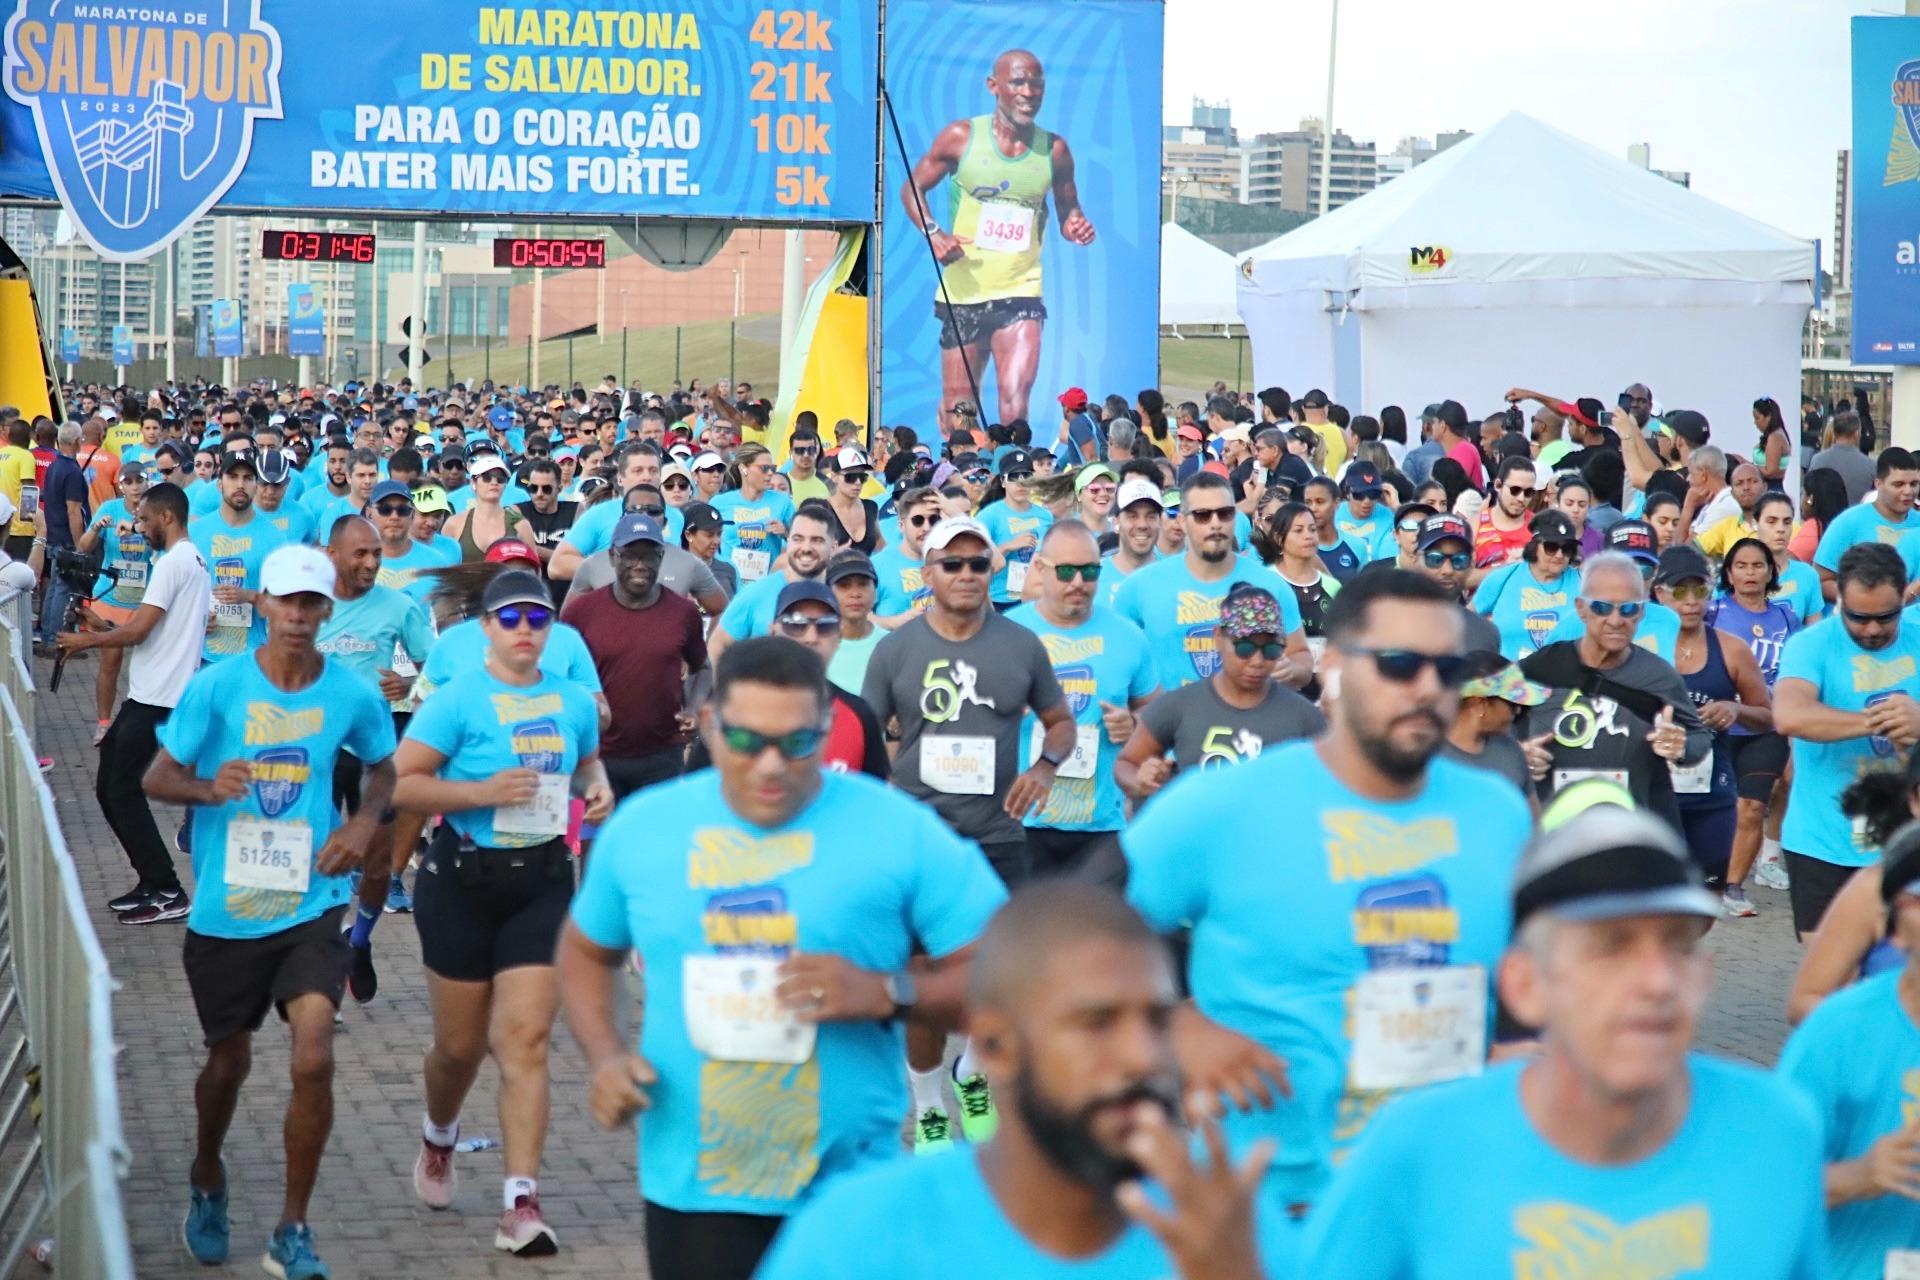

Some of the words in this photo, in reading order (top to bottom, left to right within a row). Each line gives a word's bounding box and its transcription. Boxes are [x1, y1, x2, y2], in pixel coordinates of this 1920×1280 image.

[74, 5, 178, 24] MARATONA
[184, 12, 208, 25] DE
[479, 8, 701, 50] MARATONA
[750, 10, 833, 51] 42k
[16, 20, 269, 105] SALVADOR
[420, 53, 472, 91] DE
[484, 54, 701, 97] SALVADOR.
[750, 61, 832, 103] 21k
[80, 101, 136, 114] 2023
[354, 104, 461, 144] PARA
[474, 107, 500, 145] O
[512, 103, 701, 159] CORAÇÃO
[750, 113, 832, 155] 10k
[311, 151, 437, 190] BATER
[451, 154, 553, 193] MAIS
[567, 156, 701, 196] FORTE.
[776, 165, 831, 206] 5k
[984, 219, 1024, 241] 3439
[512, 240, 602, 266] 0:50:54
[1410, 246, 1446, 269] M4
[214, 604, 243, 616] 50753
[239, 847, 292, 868] 51285
